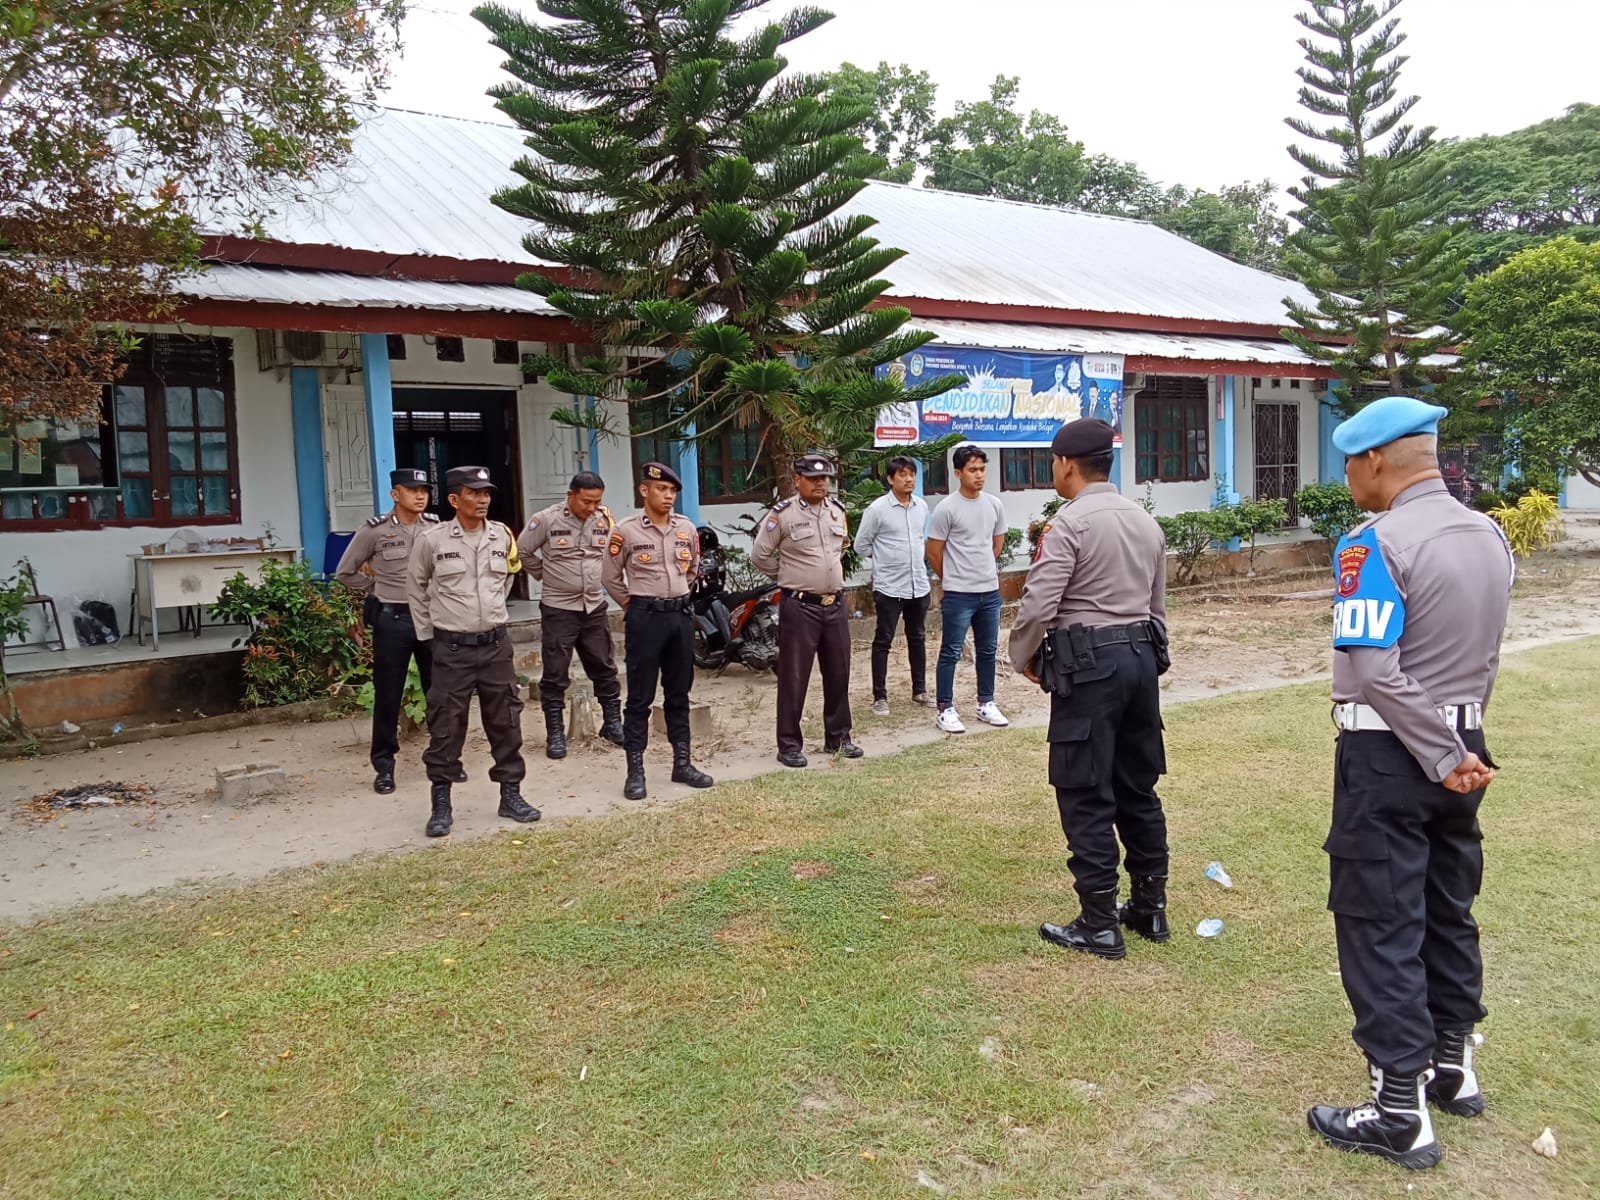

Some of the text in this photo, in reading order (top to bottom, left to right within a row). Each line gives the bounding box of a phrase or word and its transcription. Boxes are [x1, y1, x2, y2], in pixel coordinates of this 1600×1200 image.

[924, 390, 1080, 416] PENDIDIKAN NASIONAL
[1340, 546, 1366, 557] POLRES
